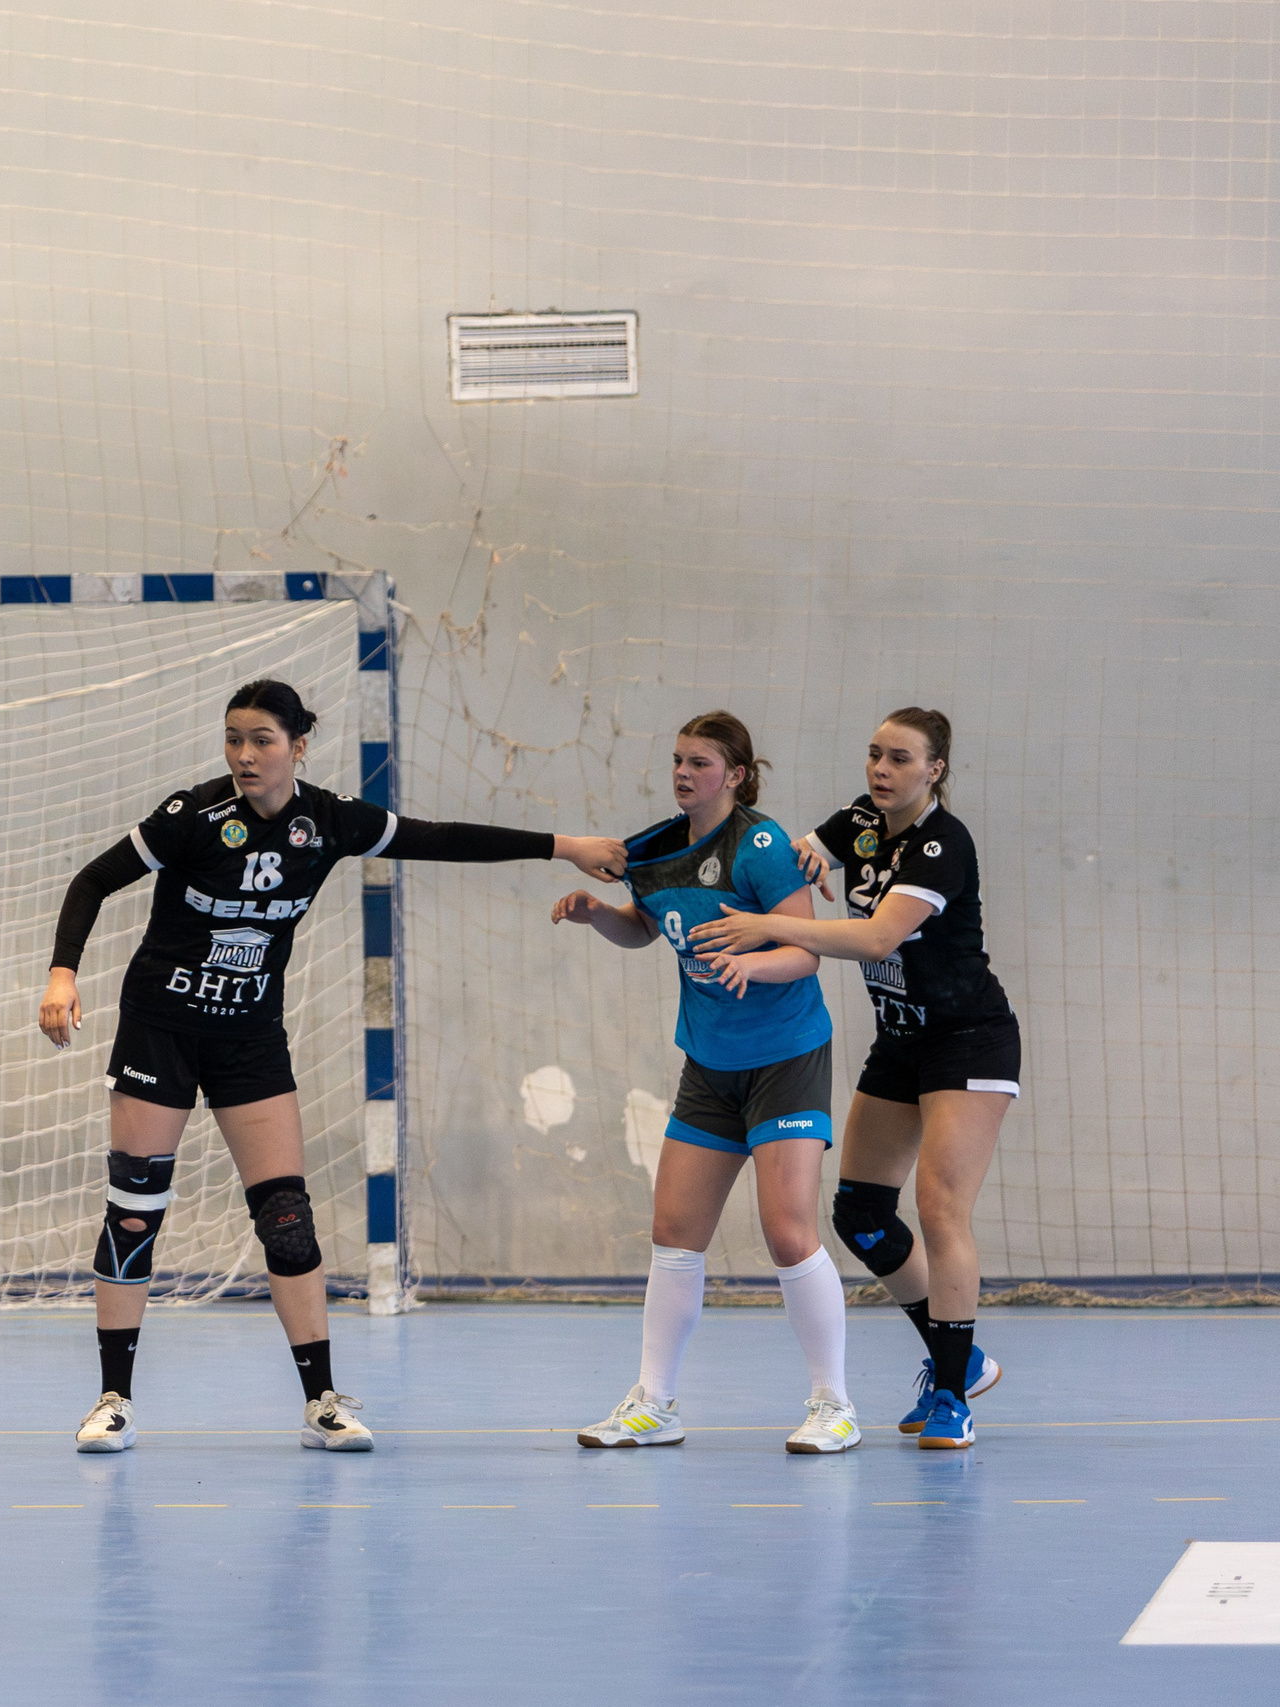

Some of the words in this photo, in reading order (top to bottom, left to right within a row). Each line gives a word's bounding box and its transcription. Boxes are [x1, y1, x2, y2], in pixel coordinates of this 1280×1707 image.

[208, 804, 237, 822] Kempa
[239, 851, 283, 891] 18
[184, 885, 311, 920] BELAZ
[665, 910, 686, 950] 9
[165, 967, 270, 1003] БНТУ
[123, 1065, 157, 1084] Kempa
[777, 1119, 813, 1130] Kempa
